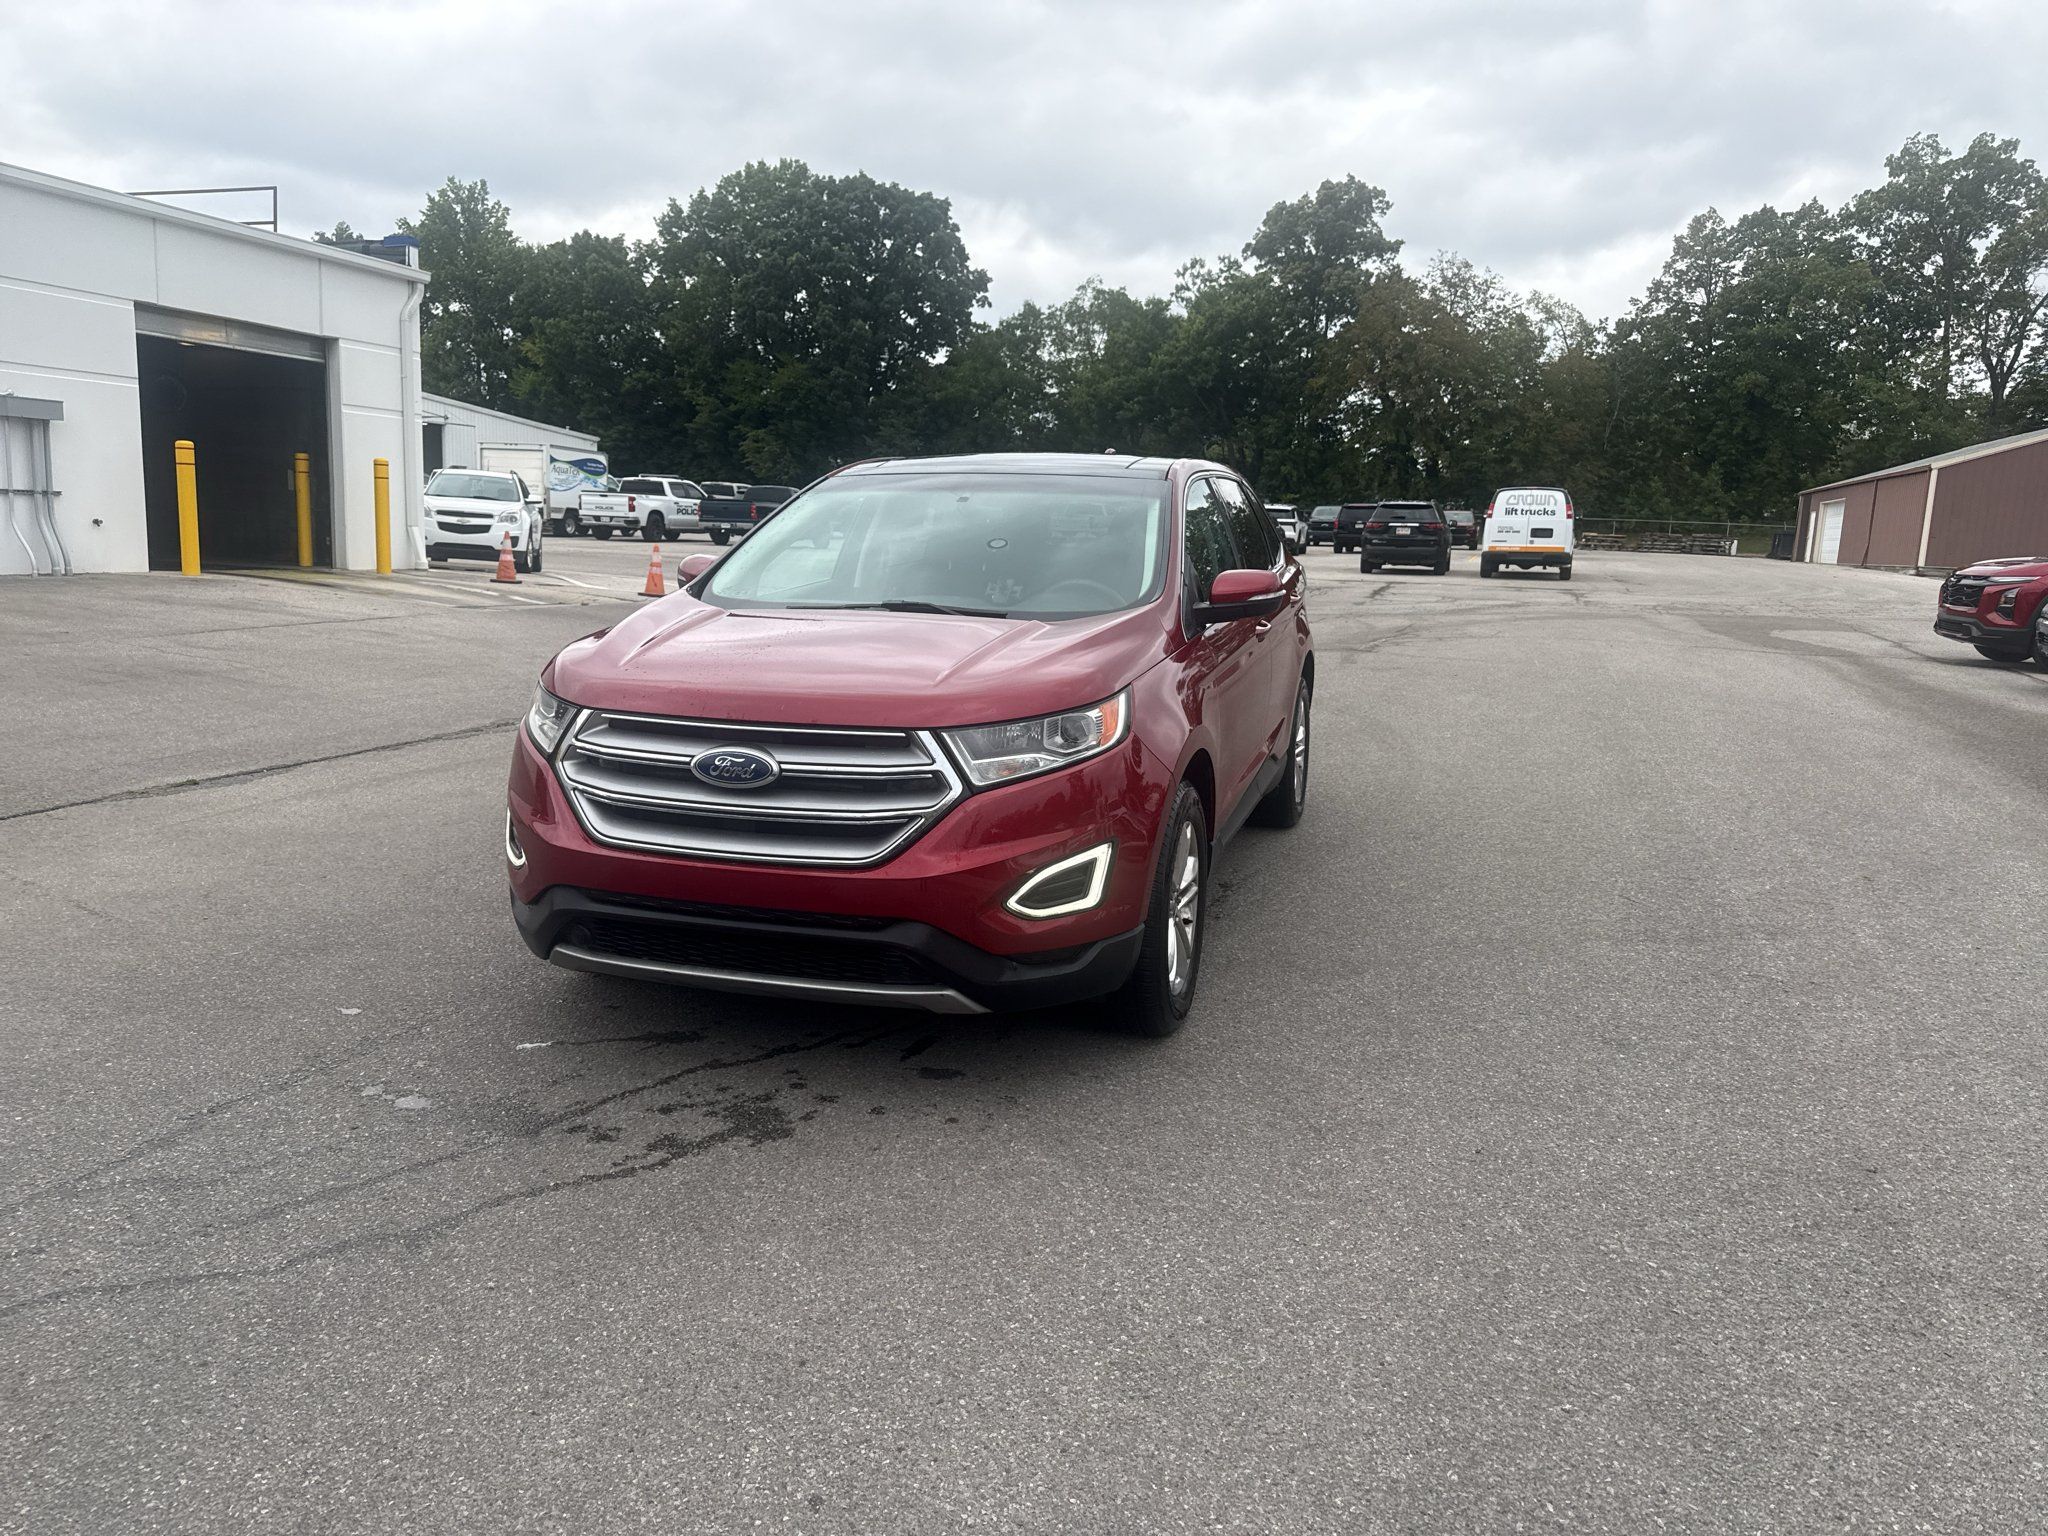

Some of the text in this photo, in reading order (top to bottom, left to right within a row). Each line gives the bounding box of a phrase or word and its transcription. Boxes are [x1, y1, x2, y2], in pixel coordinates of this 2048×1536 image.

[1504, 507, 1556, 516] lift trucks
[710, 755, 756, 778] Ford
